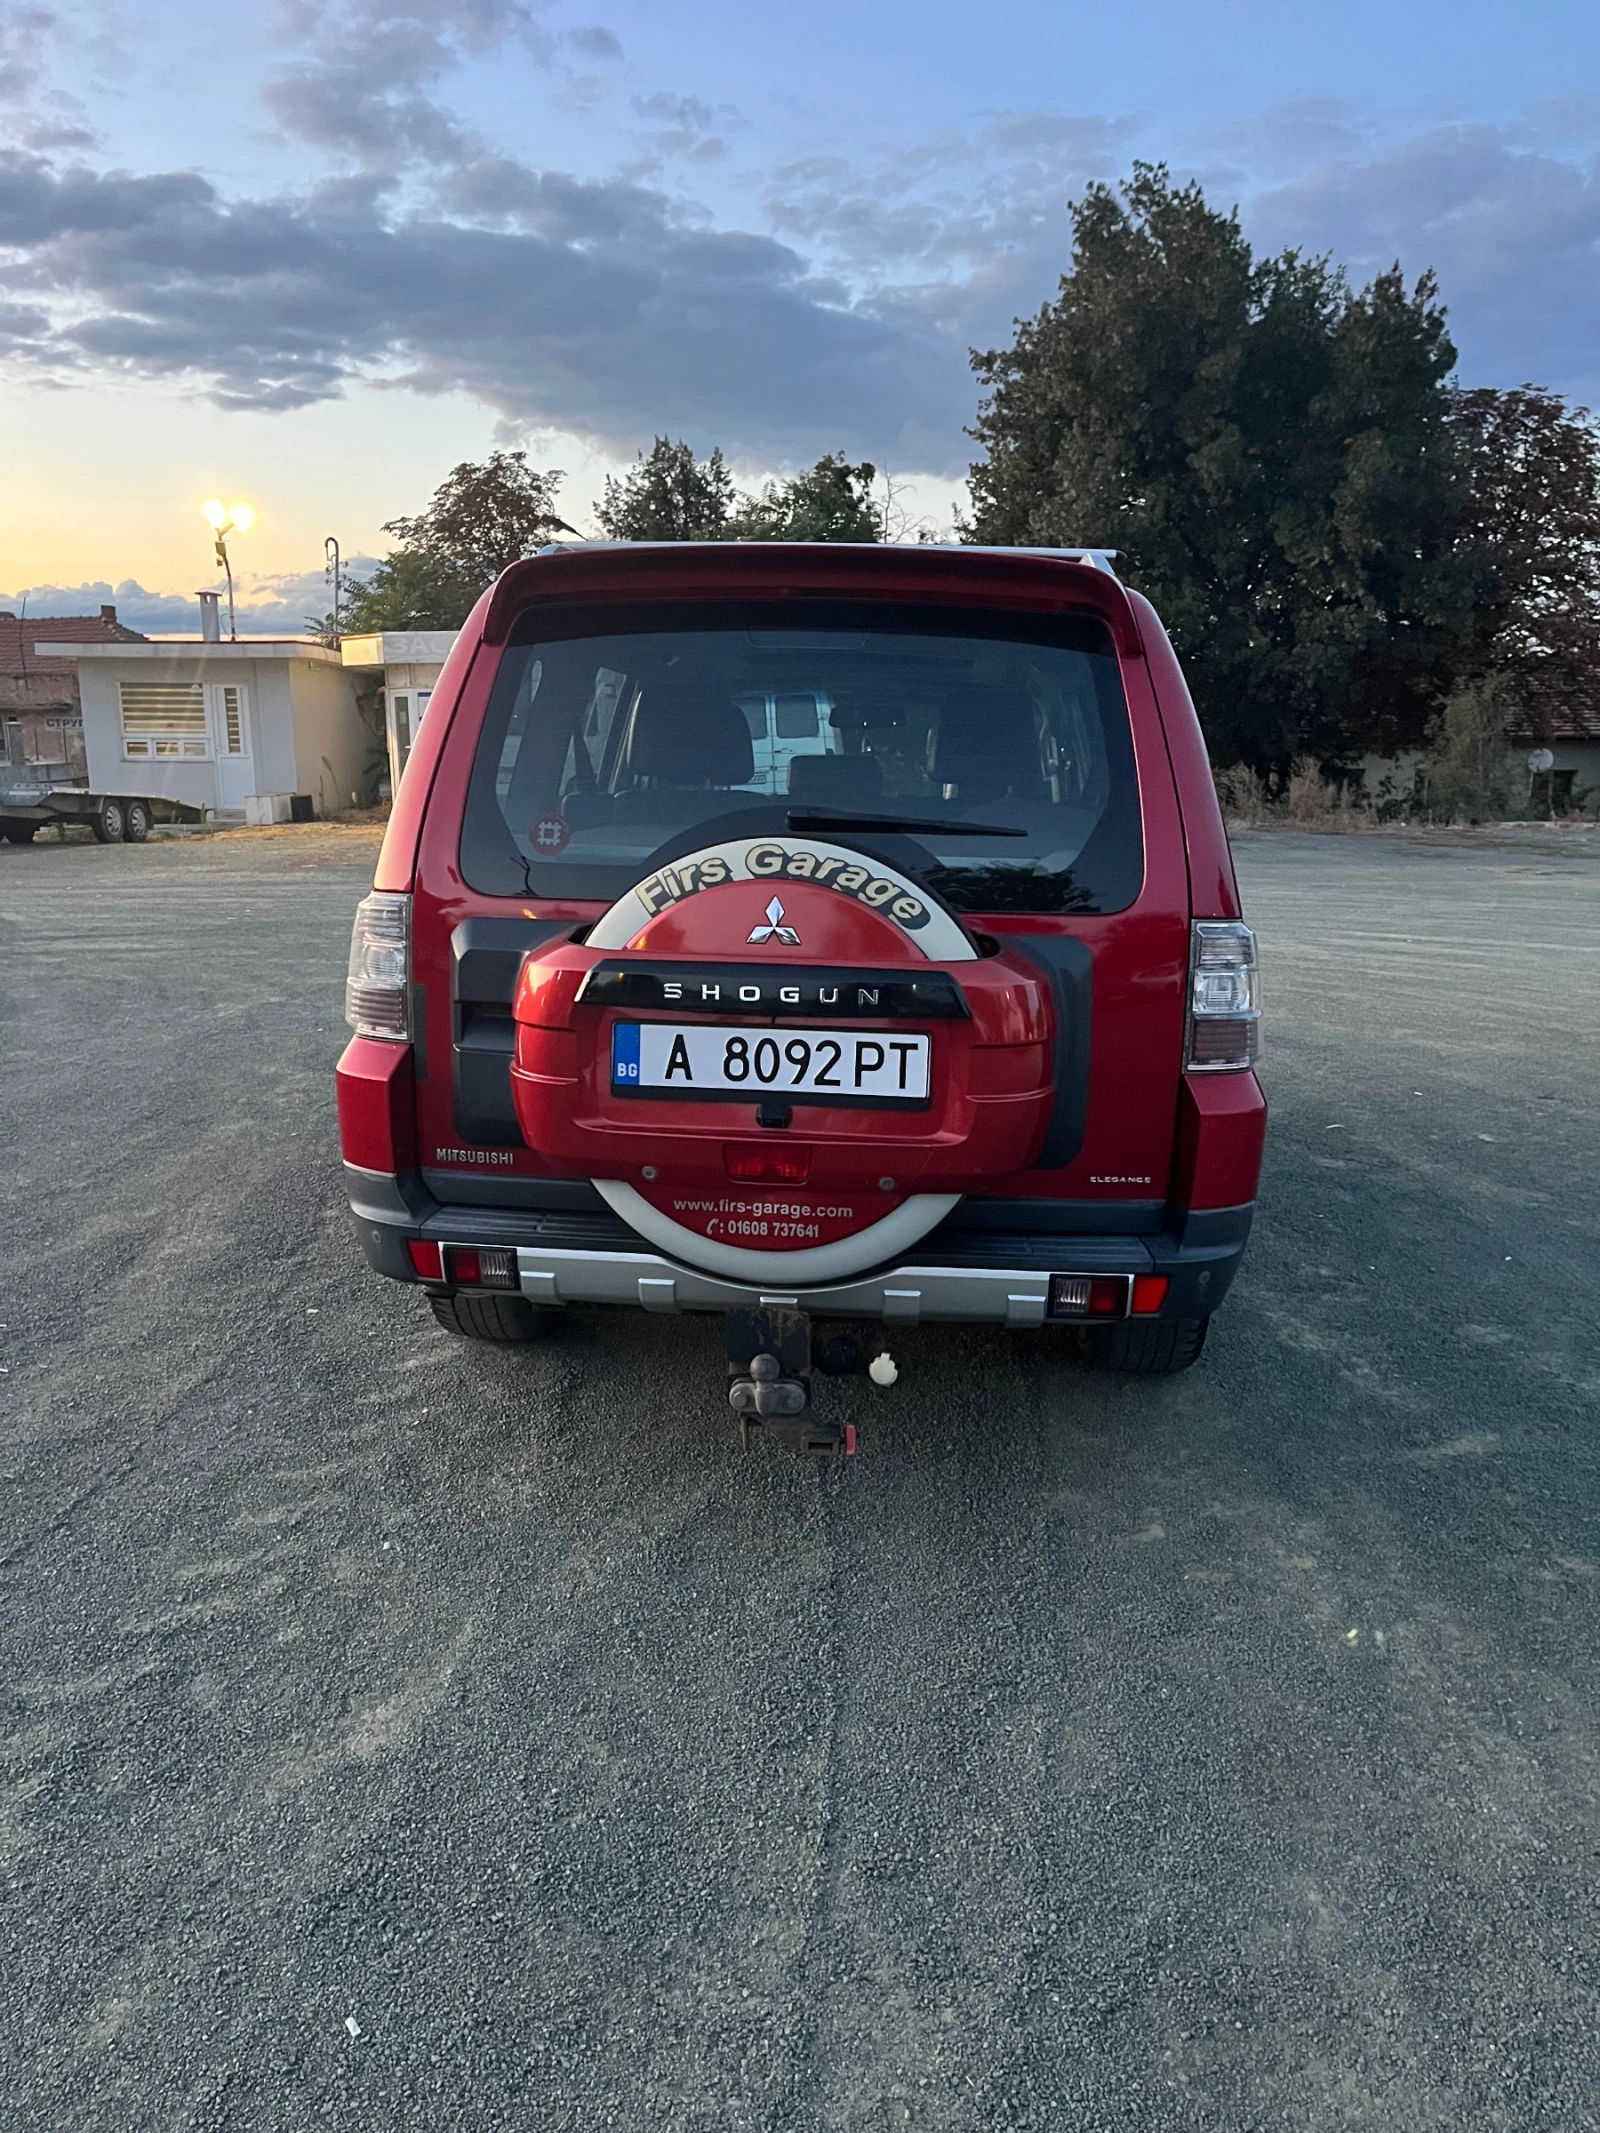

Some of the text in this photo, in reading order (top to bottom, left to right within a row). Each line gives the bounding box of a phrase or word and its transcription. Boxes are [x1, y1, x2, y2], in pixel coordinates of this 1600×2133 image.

[635, 843, 929, 928] Firs Garage
[663, 983, 879, 1005] SHOGUN
[664, 1033, 693, 1081] A
[617, 1062, 638, 1077] BG
[436, 1148, 514, 1165] MITSUBISHI
[1090, 1176, 1151, 1184] ELEGANCE
[673, 1199, 853, 1219] www.firs-garage.com
[728, 1220, 768, 1236] 01608
[772, 1222, 819, 1238] 737641
